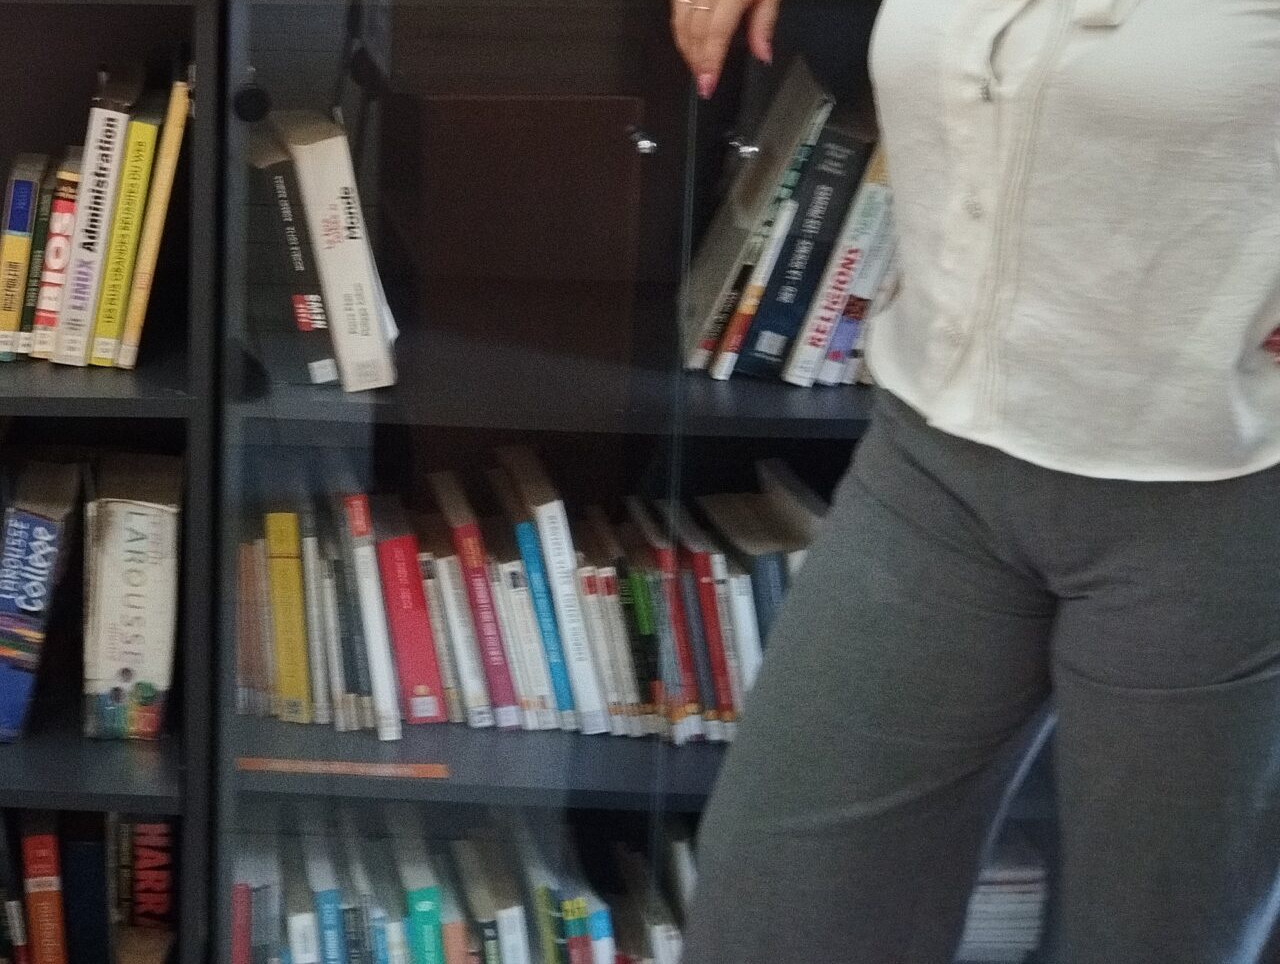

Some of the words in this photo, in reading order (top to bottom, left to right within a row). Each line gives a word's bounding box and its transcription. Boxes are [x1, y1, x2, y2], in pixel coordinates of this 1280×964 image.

[80, 115, 118, 252] Administration
[337, 186, 361, 239] Monde
[70, 258, 93, 312] LINUX
[304, 292, 327, 329] NEWS
[121, 511, 148, 665] LAROUSSE
